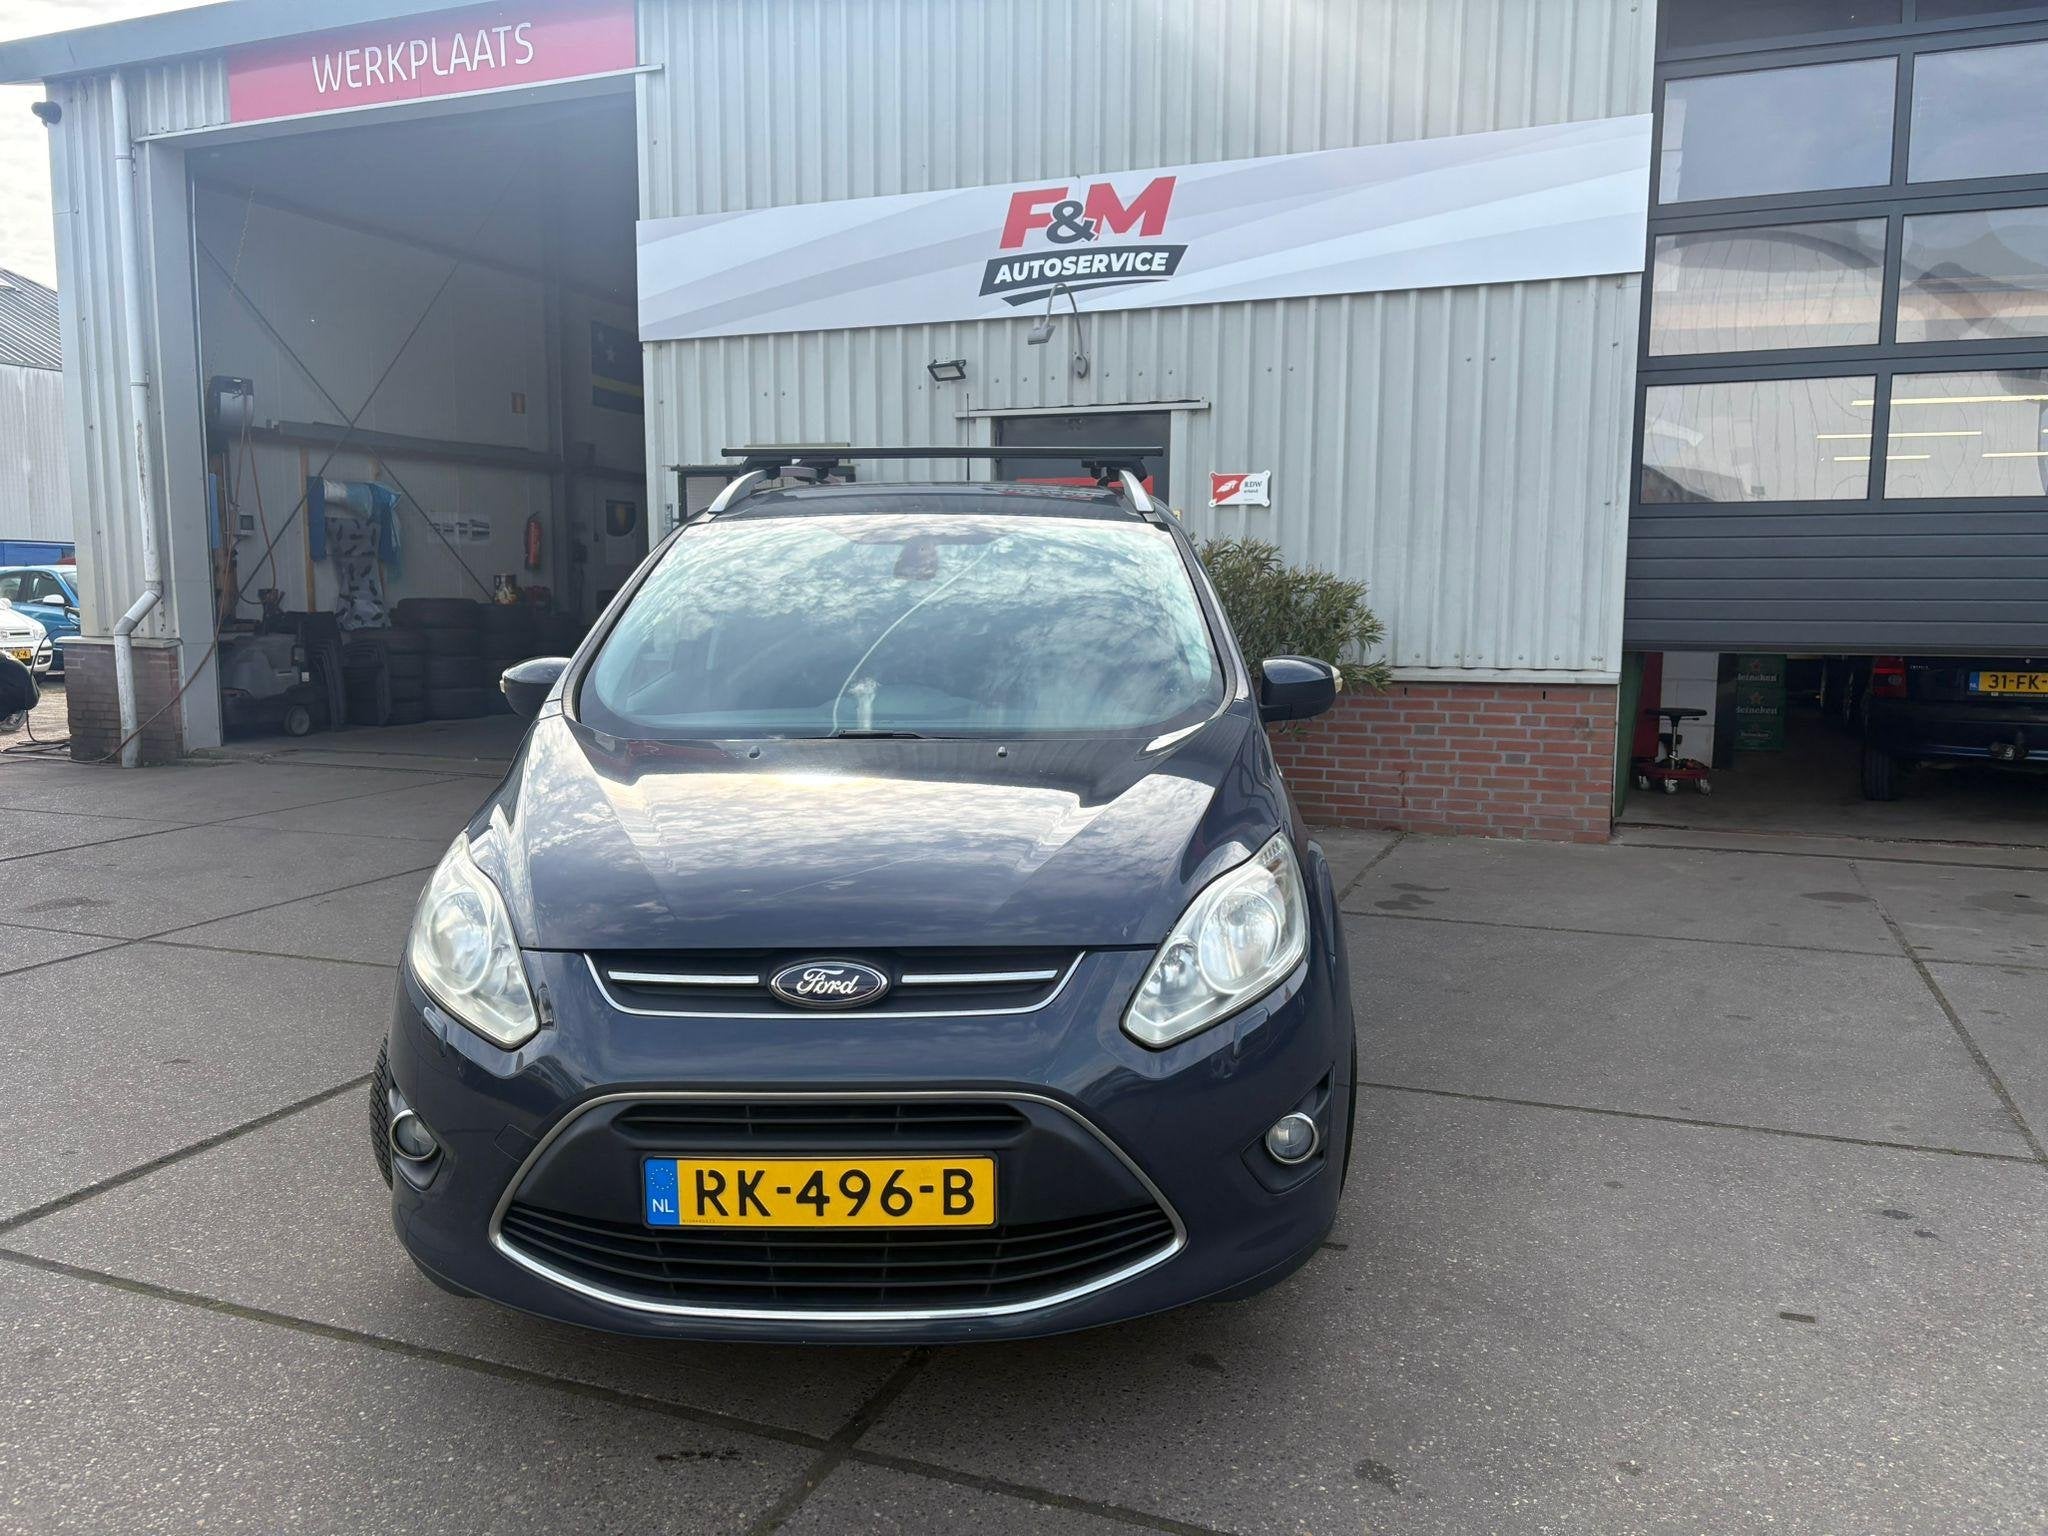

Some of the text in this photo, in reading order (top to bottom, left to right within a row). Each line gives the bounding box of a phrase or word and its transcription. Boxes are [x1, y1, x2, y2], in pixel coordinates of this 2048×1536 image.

[311, 22, 535, 94] WERKPLAATS
[1000, 175, 1177, 249] F&M
[993, 252, 1170, 285] AUTOSERVICE
[796, 968, 860, 995] Ford
[652, 1199, 674, 1213] NL
[695, 1168, 975, 1217] RK-496-B
